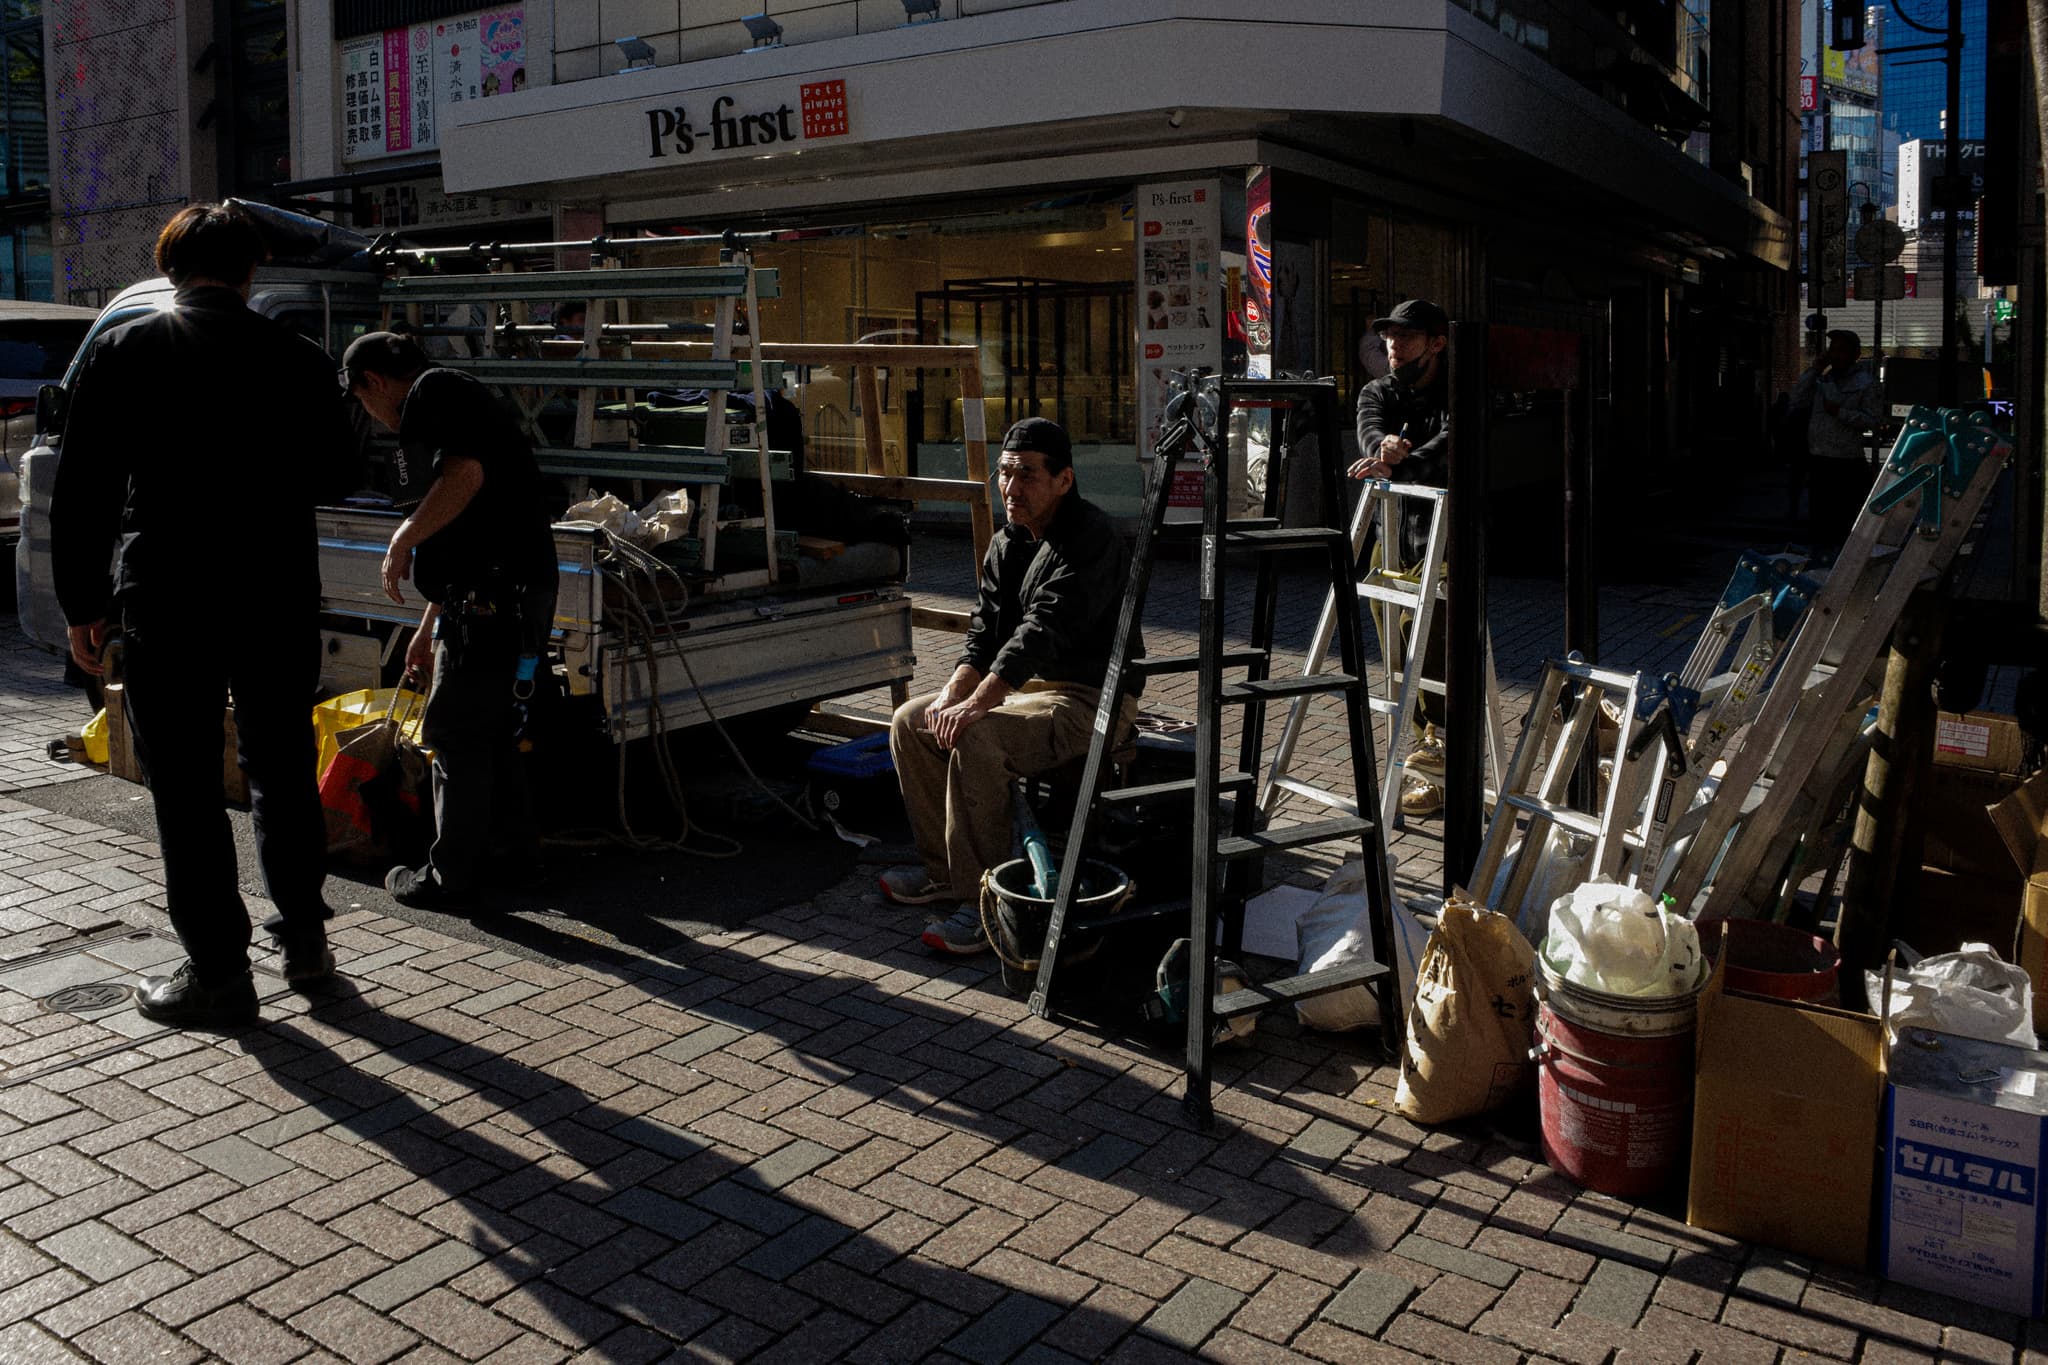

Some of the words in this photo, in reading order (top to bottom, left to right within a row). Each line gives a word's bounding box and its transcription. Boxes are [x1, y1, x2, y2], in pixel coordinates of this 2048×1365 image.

[370, 51, 381, 140] 白ロム携帯
[346, 74, 358, 144] 修理販売
[358, 71, 370, 142] 高価買取
[389, 71, 401, 148] 買取販売
[805, 98, 842, 110] always
[806, 110, 843, 121] come
[645, 96, 796, 158] P's-first
[807, 121, 844, 135] first
[346, 147, 356, 155] 3F
[1924, 144, 1947, 158] TH
[1152, 192, 1193, 206] P's-first
